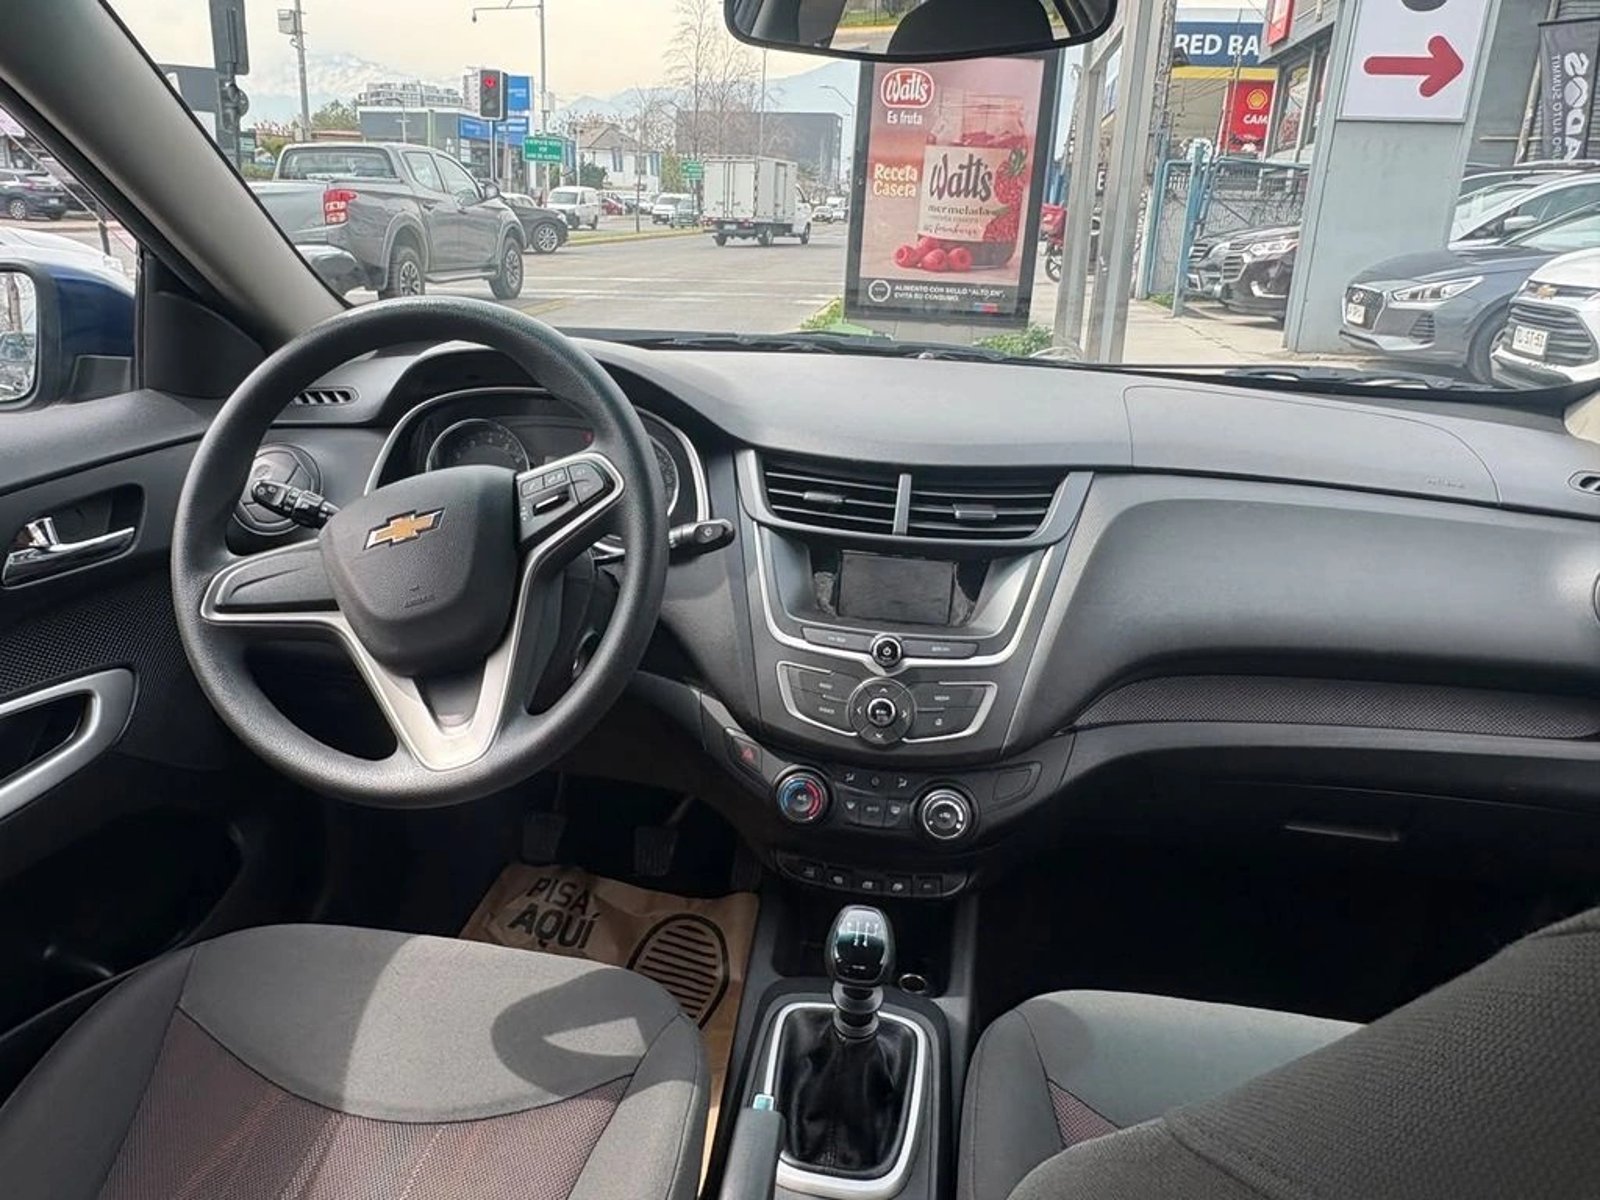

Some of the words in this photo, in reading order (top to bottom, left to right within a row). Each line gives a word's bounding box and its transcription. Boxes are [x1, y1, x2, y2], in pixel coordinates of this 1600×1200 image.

[1174, 33, 1223, 56] RED
[886, 110, 899, 124] Es
[900, 110, 923, 125] fruta
[873, 162, 919, 182] Receta
[872, 180, 917, 198] Casera
[526, 877, 590, 916] PISA
[507, 902, 601, 950] AQUÍ
